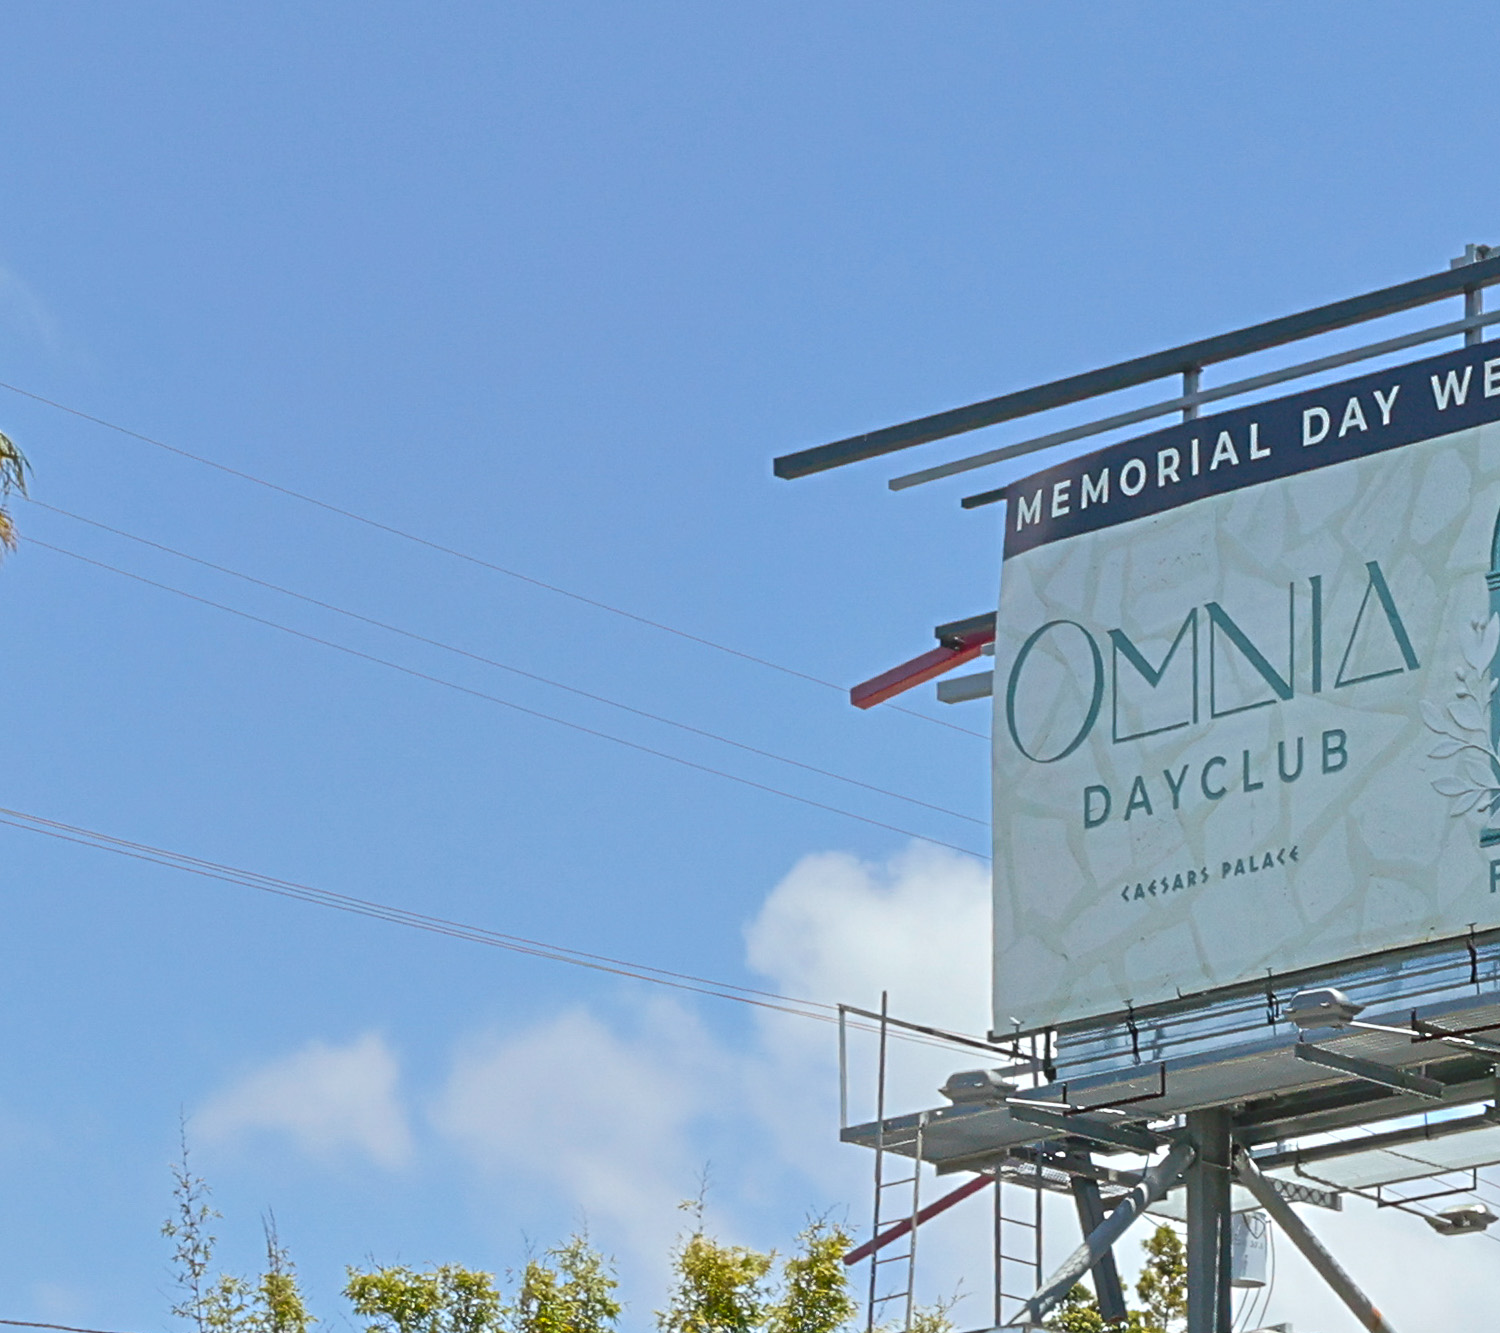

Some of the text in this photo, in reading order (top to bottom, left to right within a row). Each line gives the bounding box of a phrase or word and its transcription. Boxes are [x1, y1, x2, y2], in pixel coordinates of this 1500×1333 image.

[1016, 422, 1271, 531] MEMORIAL
[1302, 385, 1400, 447] DAY
[1006, 560, 1420, 764] OMNIA
[1084, 729, 1348, 829] DAYCLUB
[1121, 845, 1299, 901] CAESARS PALACE
